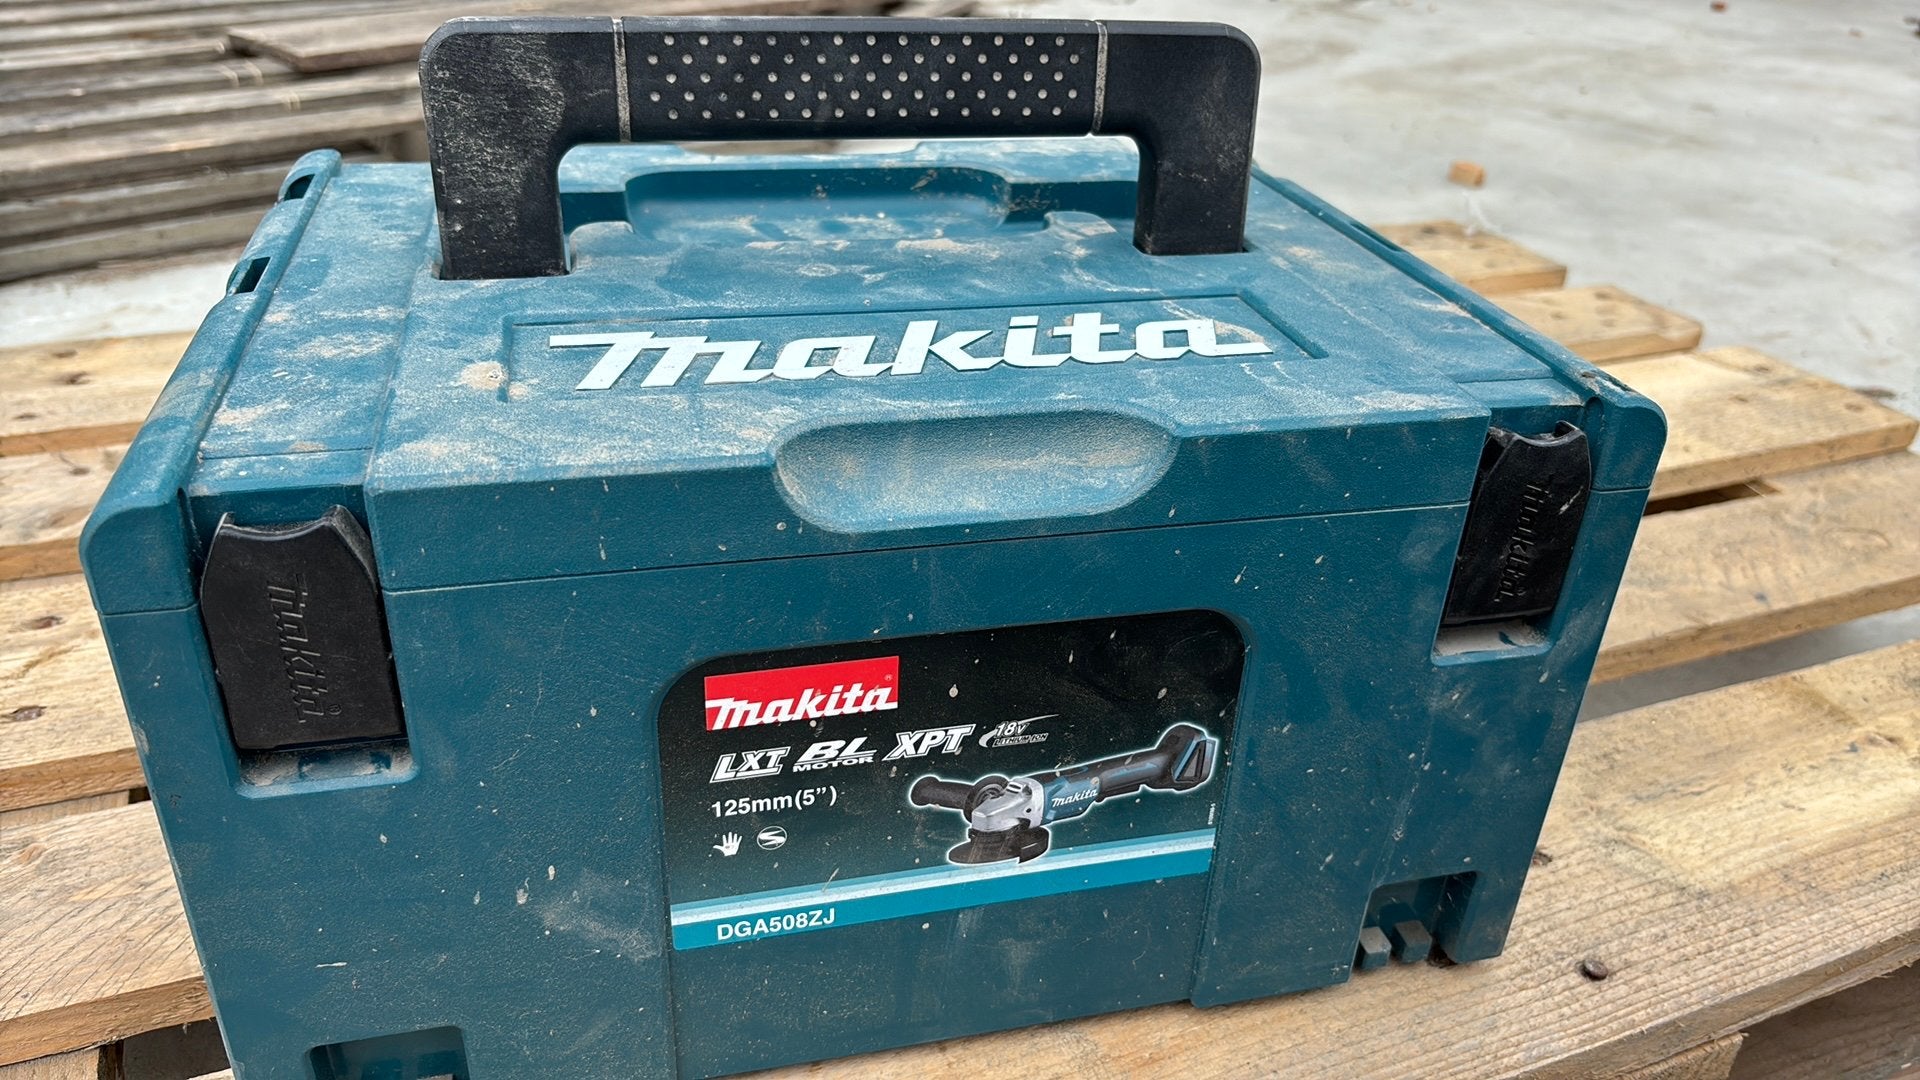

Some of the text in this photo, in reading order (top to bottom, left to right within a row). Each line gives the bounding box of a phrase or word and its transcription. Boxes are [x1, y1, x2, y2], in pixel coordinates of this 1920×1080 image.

[549, 312, 1274, 391] makita
[705, 683, 898, 730] makita
[794, 736, 877, 765] BL
[881, 723, 977, 761] XPT
[709, 746, 791, 784] LXT
[792, 756, 874, 773] MOTOR
[1052, 788, 1098, 808] makita
[717, 907, 836, 941] DGA508ZJ
